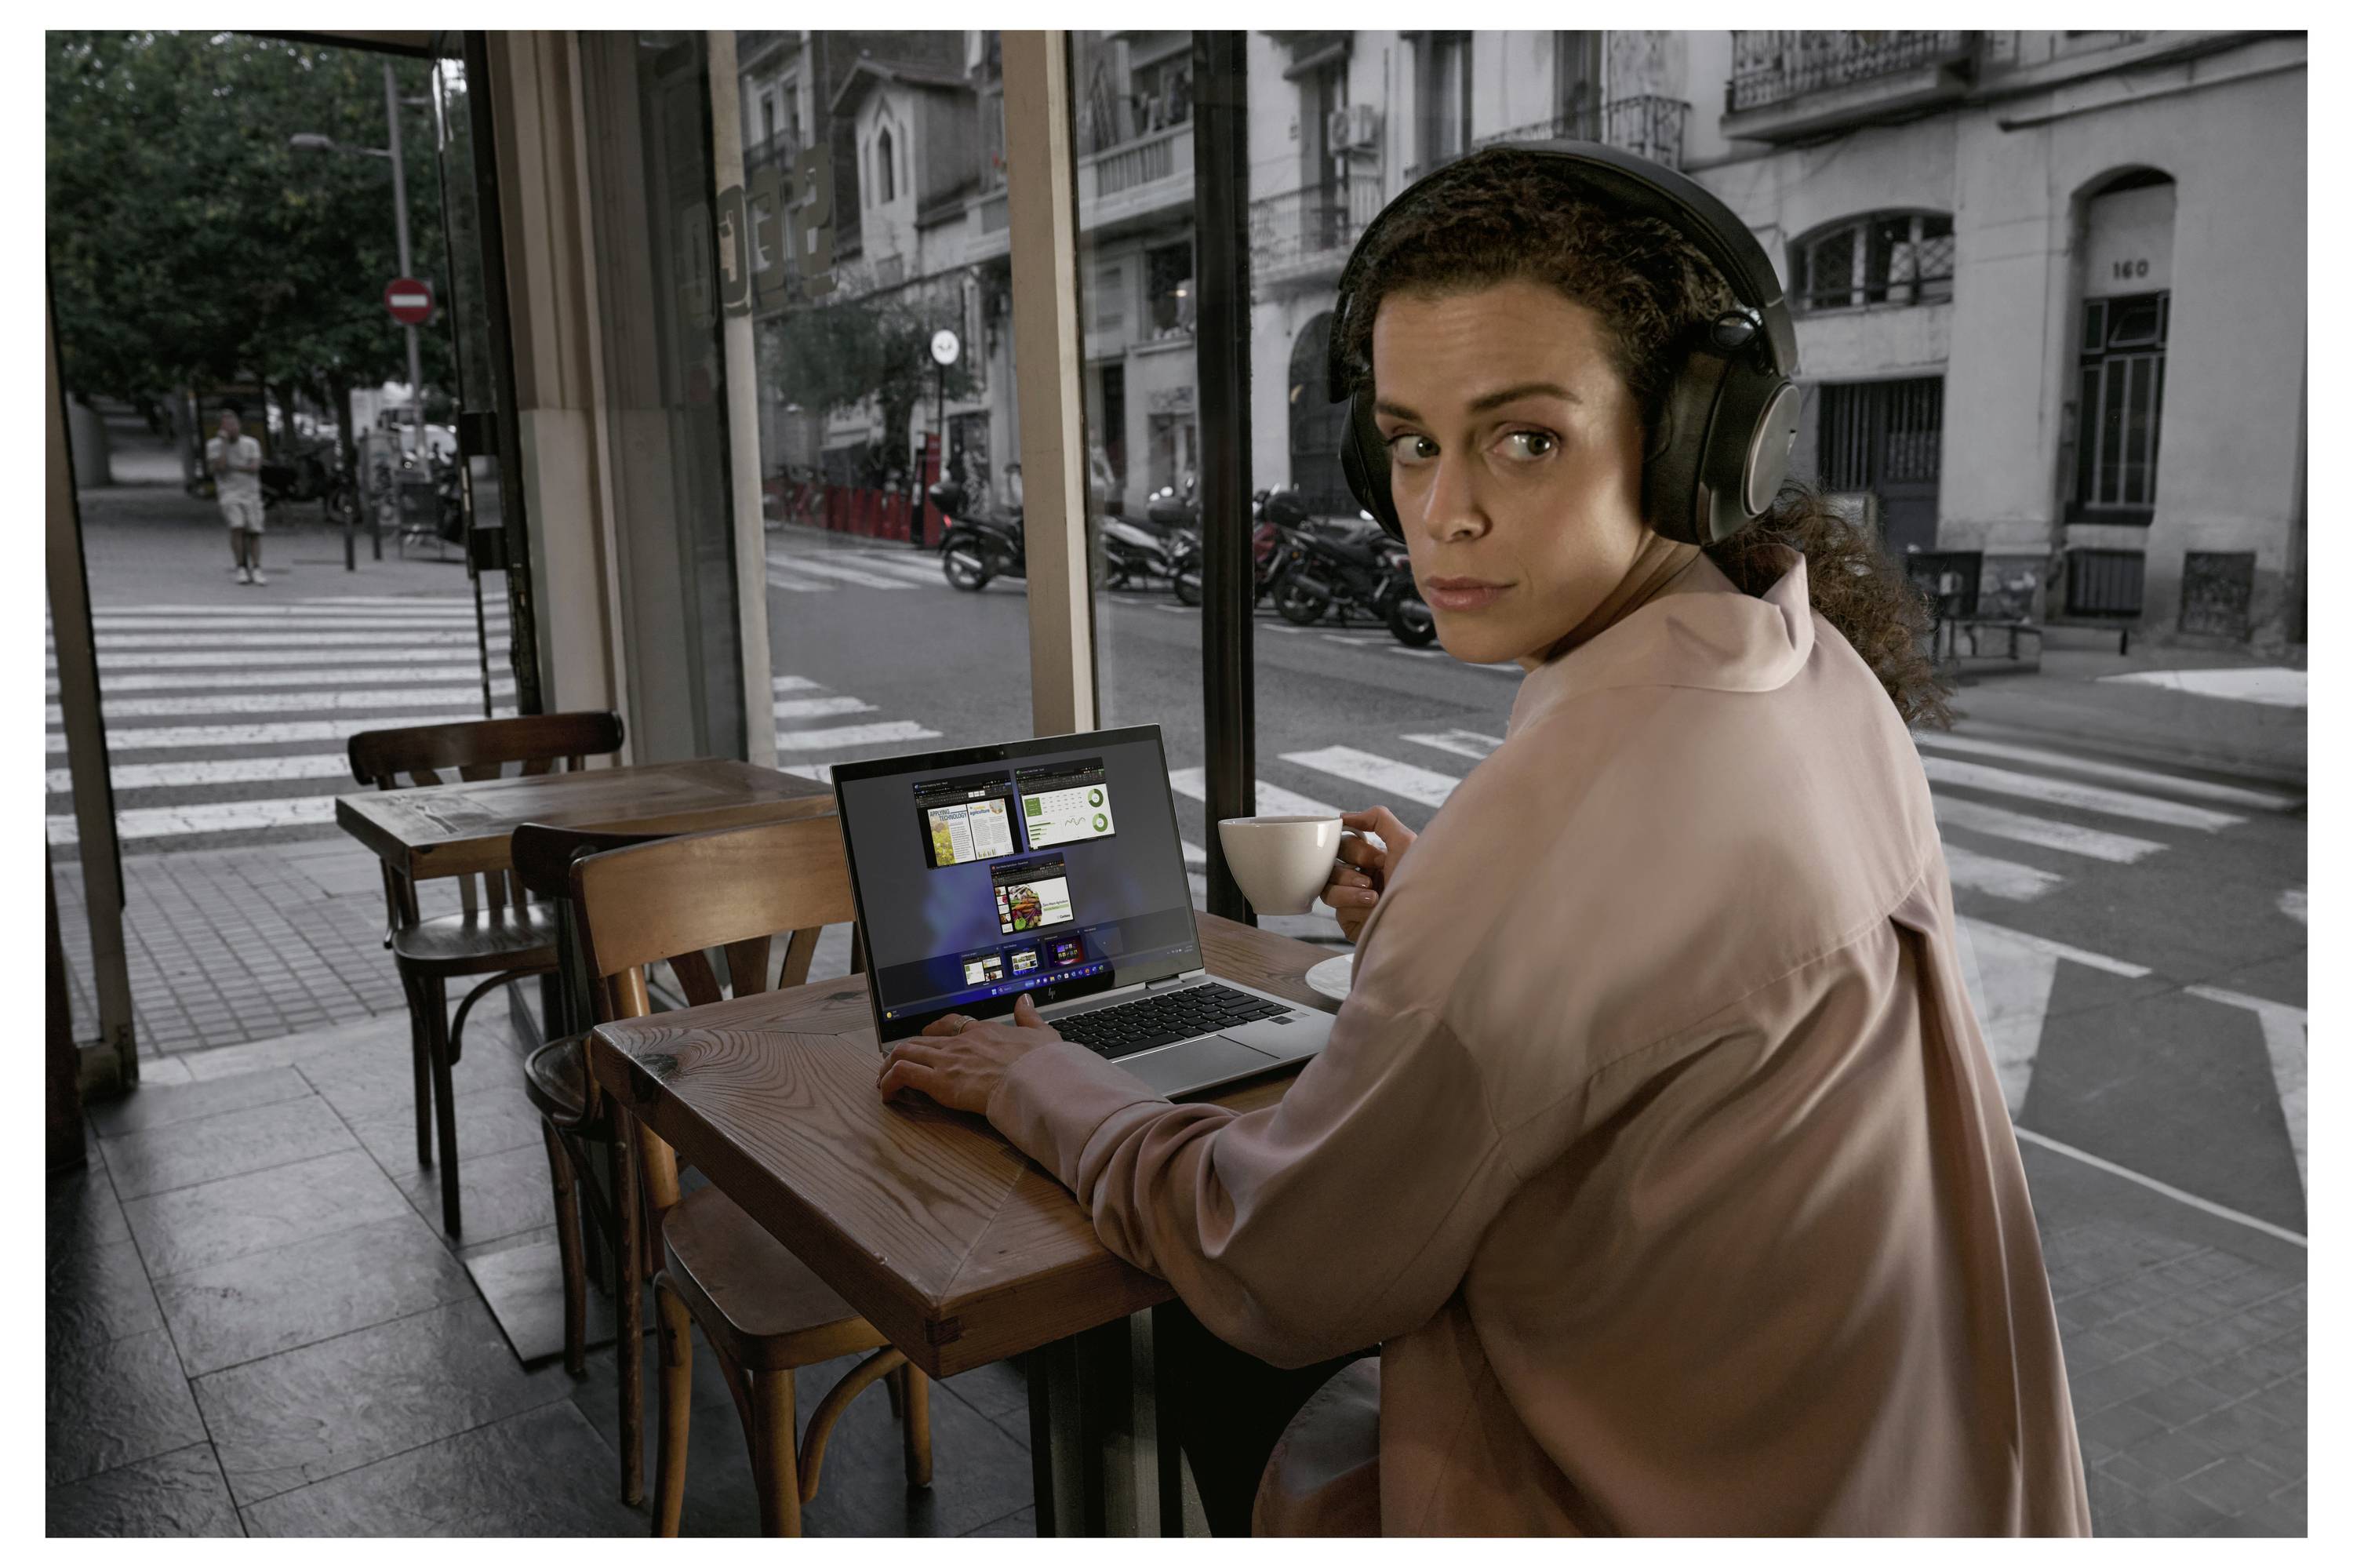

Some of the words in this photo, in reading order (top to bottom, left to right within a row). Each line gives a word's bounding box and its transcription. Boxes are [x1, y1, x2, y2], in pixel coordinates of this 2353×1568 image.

[2112, 258, 2150, 281] 160
[929, 809, 951, 817] APPLYING
[939, 812, 967, 821] TECHNOLOGY
